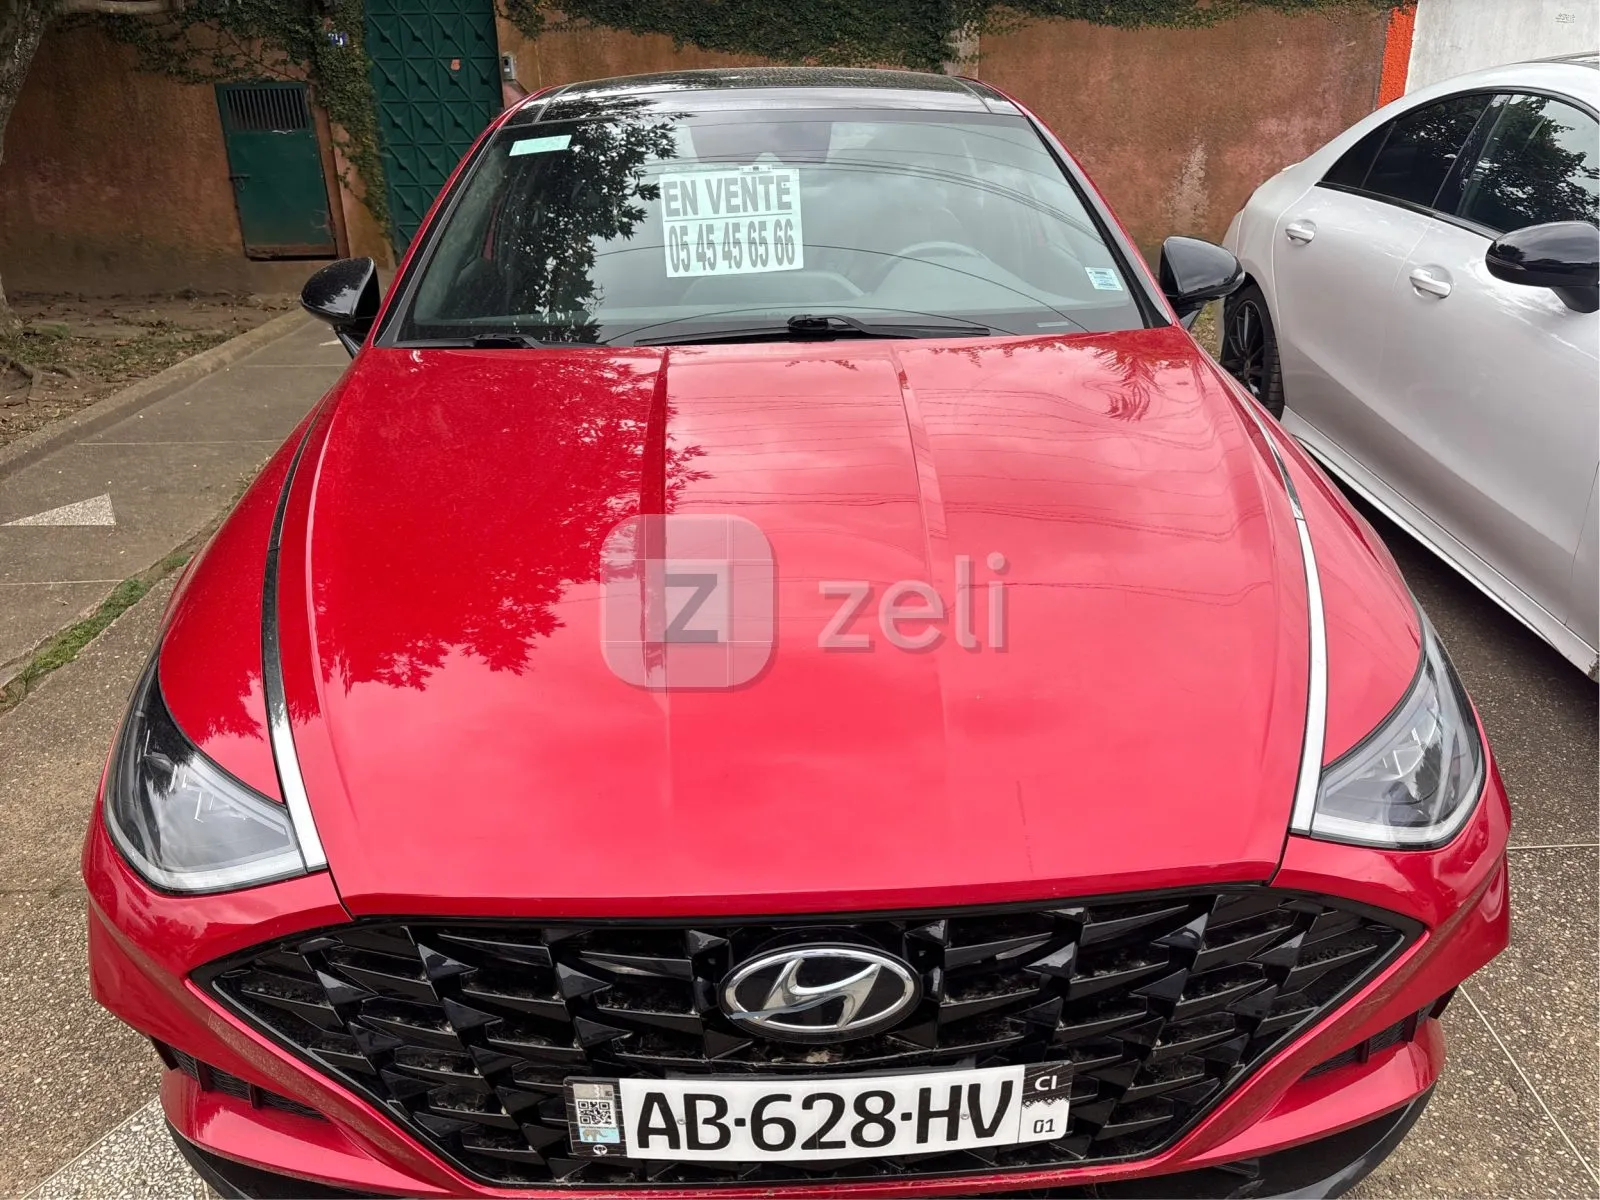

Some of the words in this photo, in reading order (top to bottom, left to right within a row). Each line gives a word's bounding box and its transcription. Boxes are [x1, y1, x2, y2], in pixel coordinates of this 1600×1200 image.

[663, 180, 699, 217] EN
[705, 175, 792, 214] VENTE
[668, 225, 691, 273] 05
[696, 223, 717, 271] 45
[722, 222, 743, 269] 45
[747, 220, 769, 268] 65
[773, 218, 795, 266] 66
[1034, 1075, 1057, 1091] CI
[1033, 1118, 1056, 1134] 01
